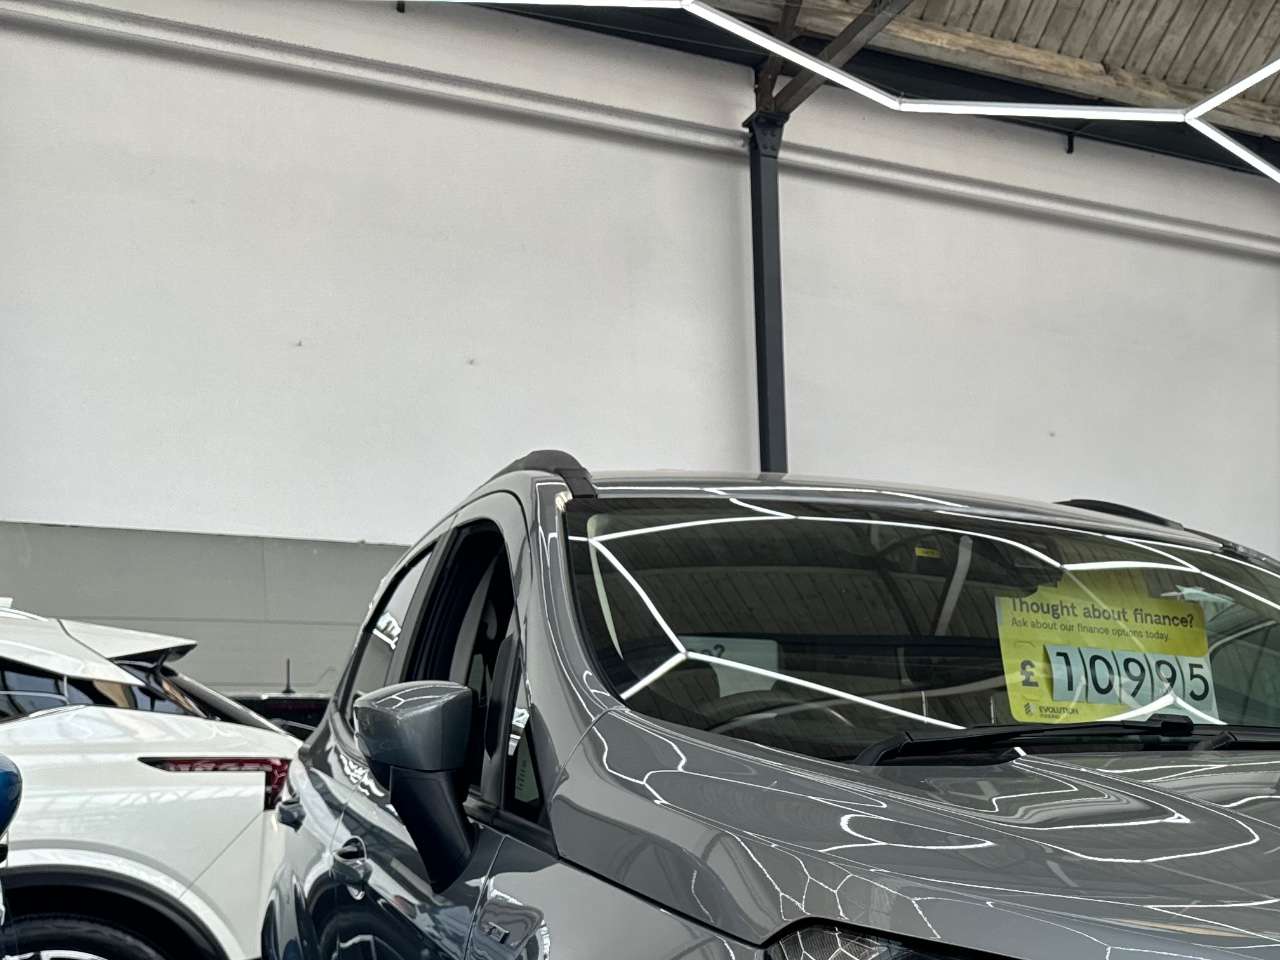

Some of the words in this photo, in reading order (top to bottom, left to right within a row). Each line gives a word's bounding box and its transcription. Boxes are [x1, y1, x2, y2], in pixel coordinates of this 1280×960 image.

[1011, 596, 1078, 620] Thought
[1083, 604, 1127, 622] about
[1133, 608, 1194, 629] finance?
[1010, 617, 1028, 627] Ask
[1030, 619, 1057, 631] about
[1059, 623, 1074, 632] our
[1077, 623, 1109, 635] finance
[1145, 630, 1168, 642] today
[1055, 651, 1210, 701] 10995
